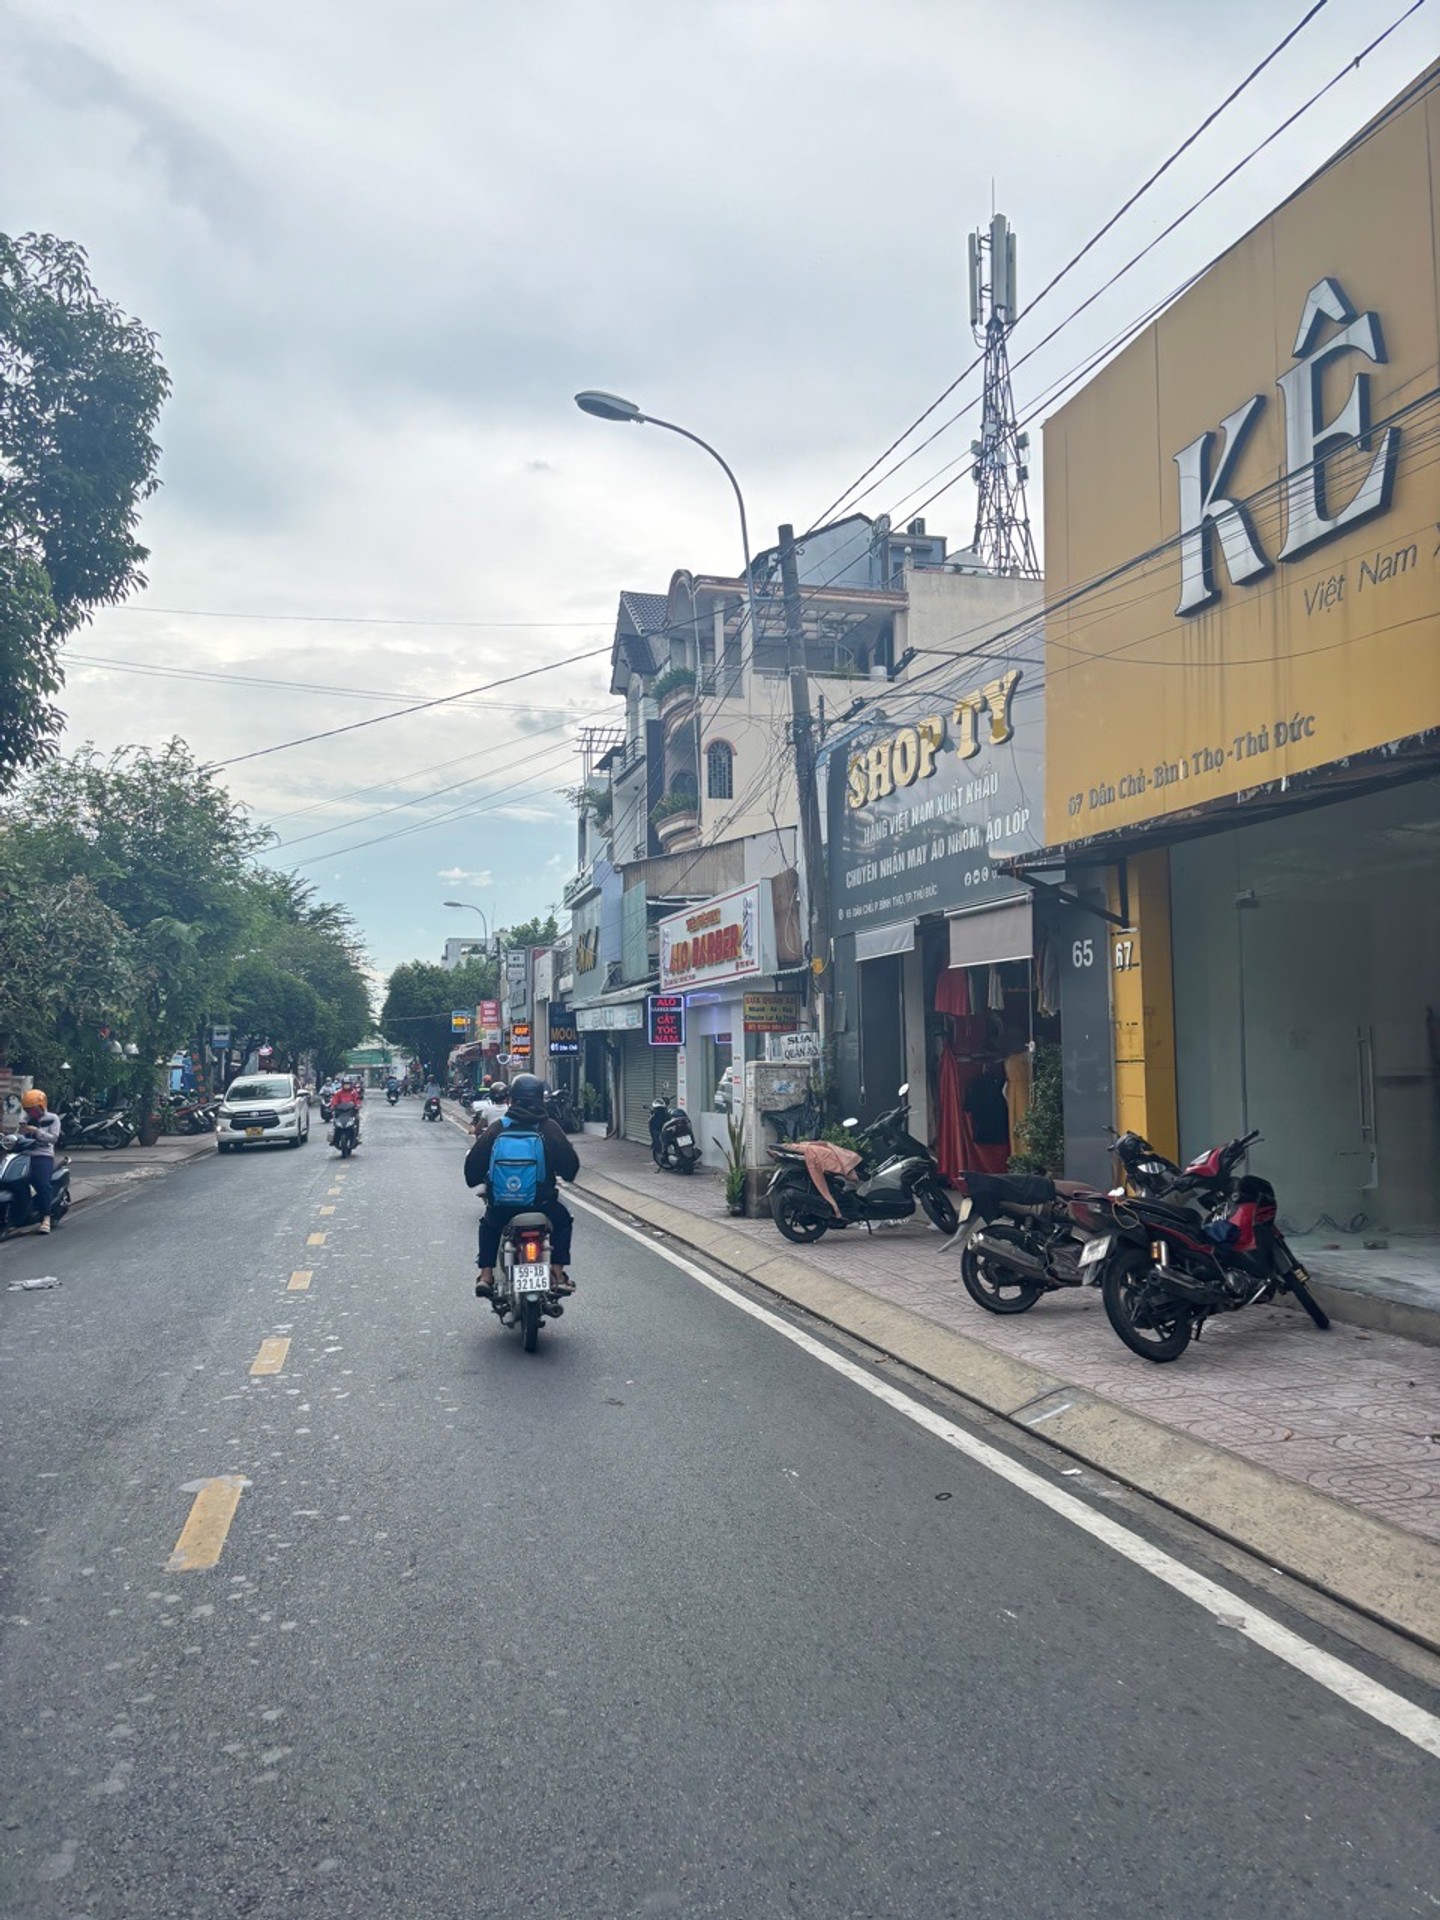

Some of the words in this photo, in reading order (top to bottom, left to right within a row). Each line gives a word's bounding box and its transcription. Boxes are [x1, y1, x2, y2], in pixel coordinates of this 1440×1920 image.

[1173, 276, 1402, 617] KÊ
[1303, 573, 1346, 617] Việt
[1358, 543, 1417, 593] Nam
[849, 713, 946, 809] SHOP
[951, 668, 1024, 760] TY
[1068, 793, 1083, 816] 67
[1089, 782, 1116, 810] Dân
[1274, 712, 1316, 747] Đức
[911, 799, 935, 827] NAM
[937, 778, 964, 817] XUẤT
[880, 847, 905, 879] NHẬN
[907, 844, 928, 870] MAY
[931, 834, 945, 861] ÁO
[986, 815, 1002, 844] ÁO
[1006, 804, 1030, 837] LỚP
[692, 923, 742, 970] BARBER
[1072, 939, 1094, 968] 65
[1115, 941, 1133, 972] 67
[655, 1034, 679, 1043] NAM
[656, 1025, 677, 1034] TÓC
